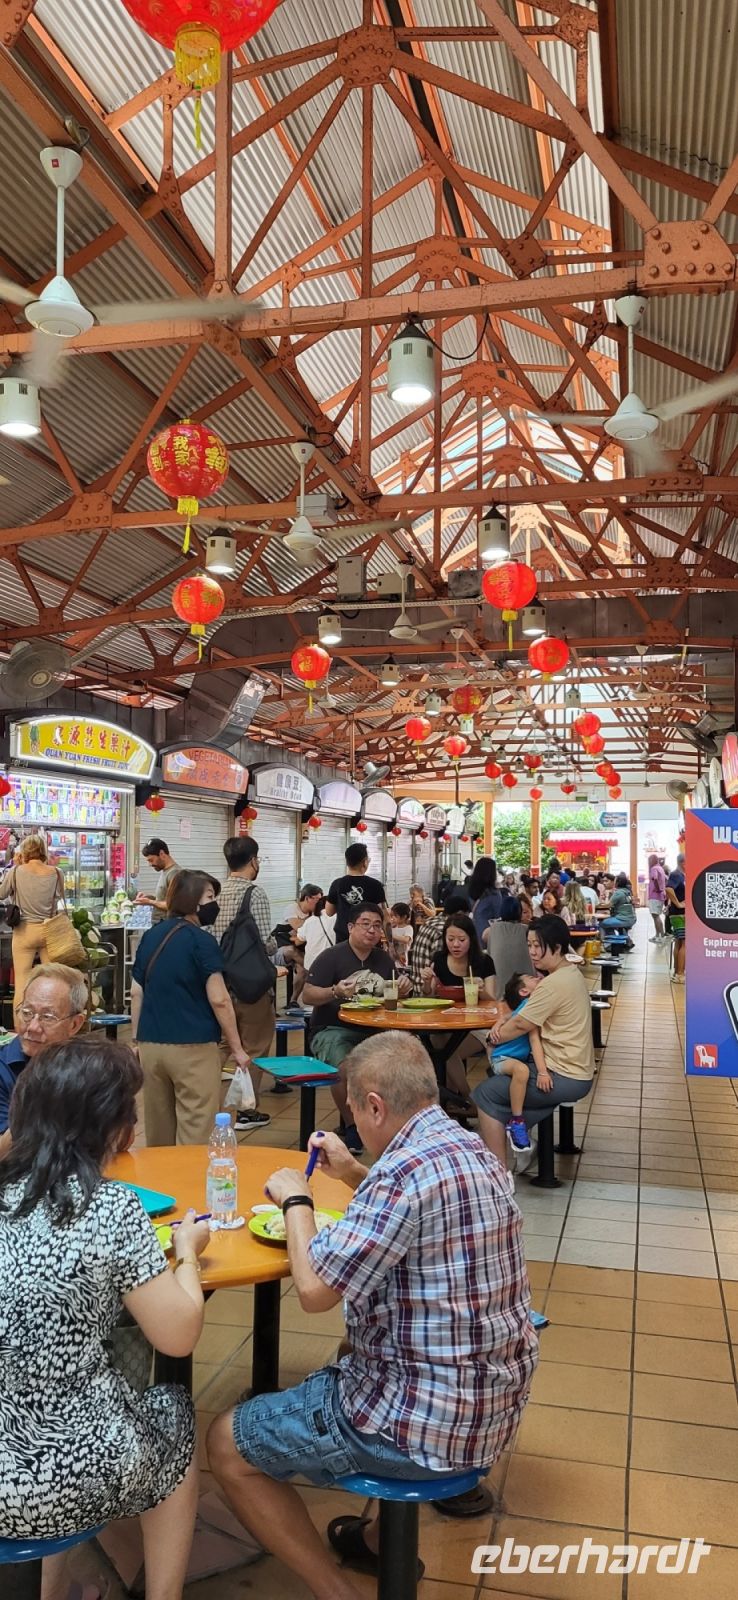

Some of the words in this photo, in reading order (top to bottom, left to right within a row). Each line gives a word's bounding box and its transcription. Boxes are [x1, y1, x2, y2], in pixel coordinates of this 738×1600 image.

[45, 747, 63, 759] QUAN
[64, 751, 81, 762] YUAN
[82, 754, 100, 765] FRESH
[101, 757, 116, 768] FRUIT
[703, 937, 738, 949] Explore
[705, 947, 726, 958] beer
